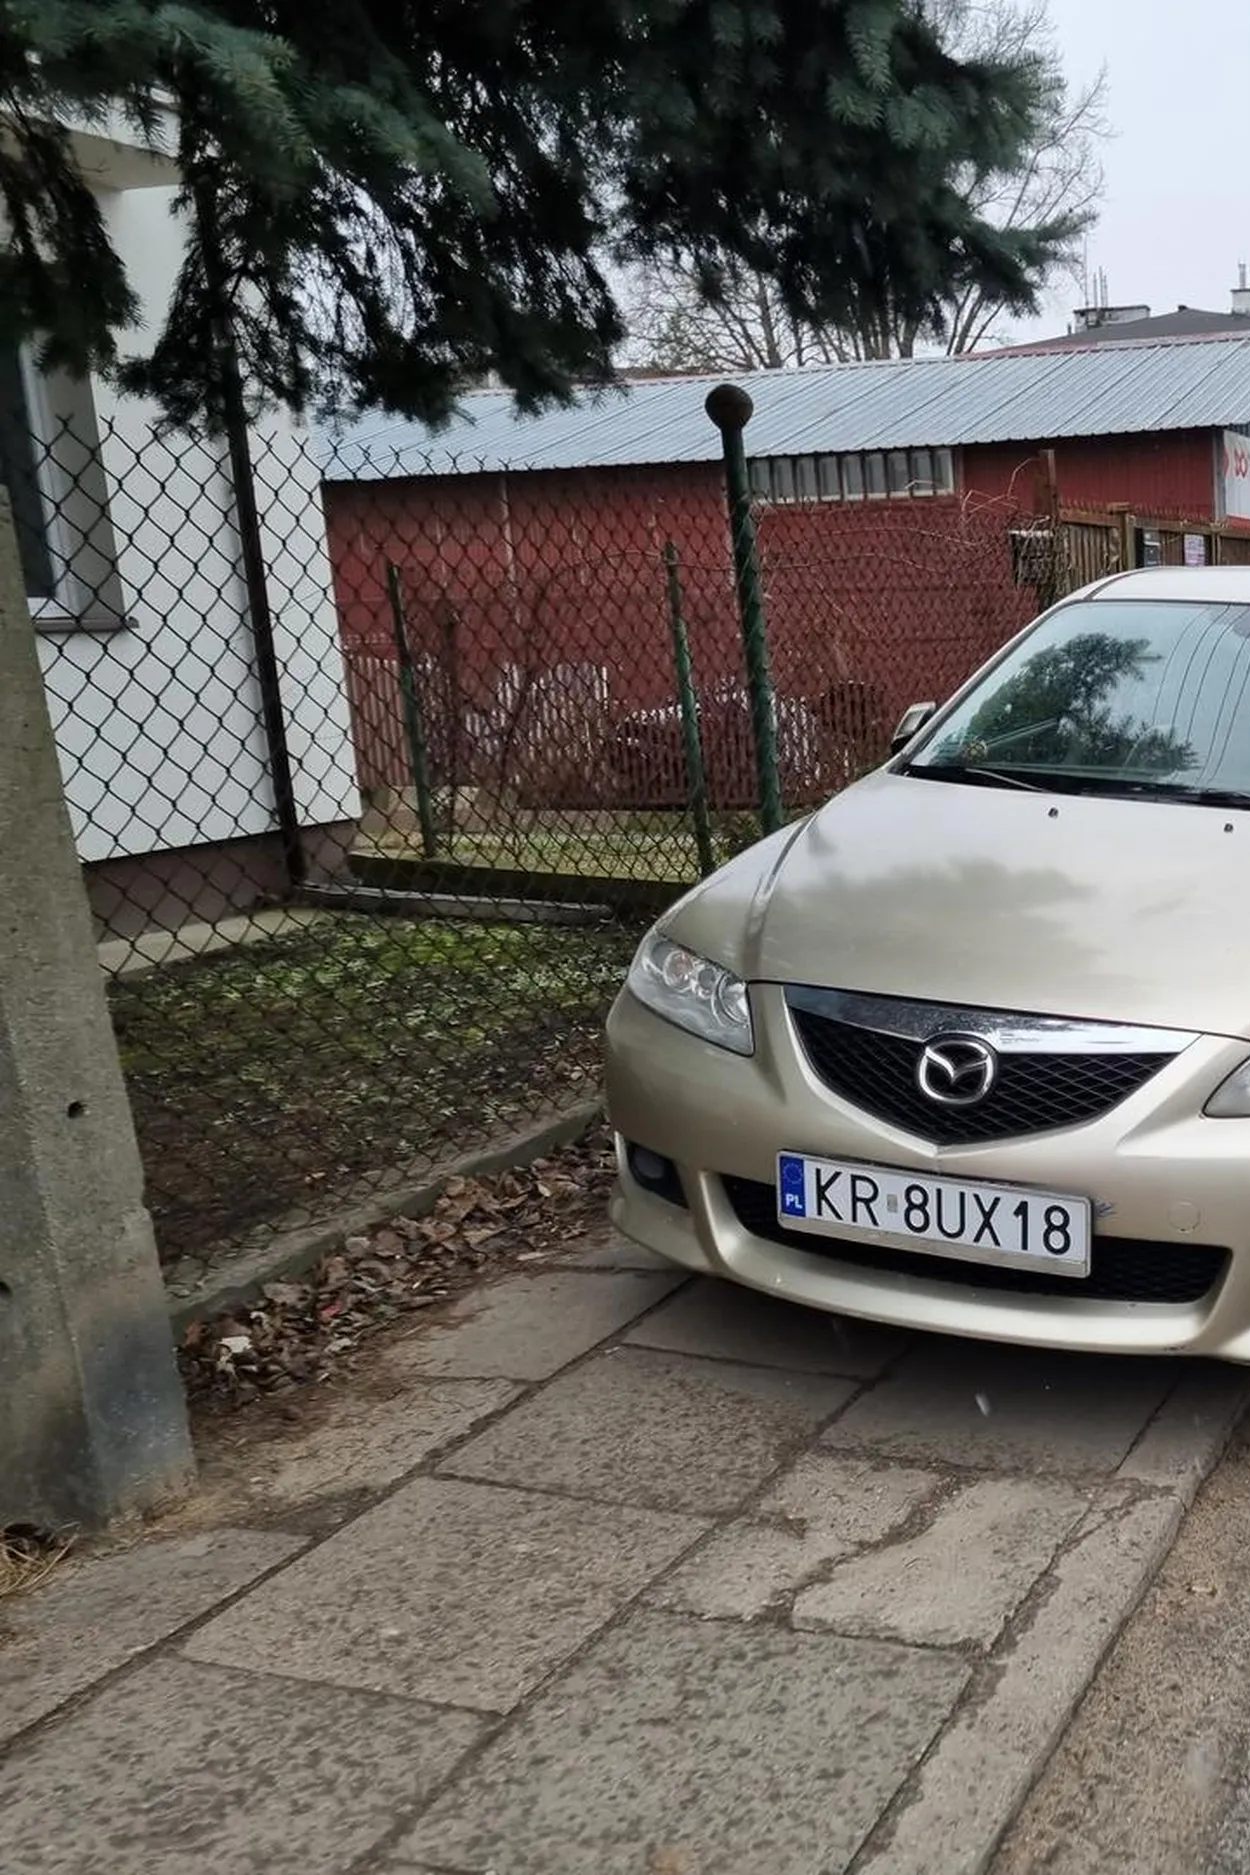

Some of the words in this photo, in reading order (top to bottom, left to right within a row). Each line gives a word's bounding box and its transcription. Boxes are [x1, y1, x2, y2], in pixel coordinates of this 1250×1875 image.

[786, 1193, 803, 1209] PL
[815, 1167, 879, 1227] KR
[903, 1183, 1071, 1256] 8UX18
